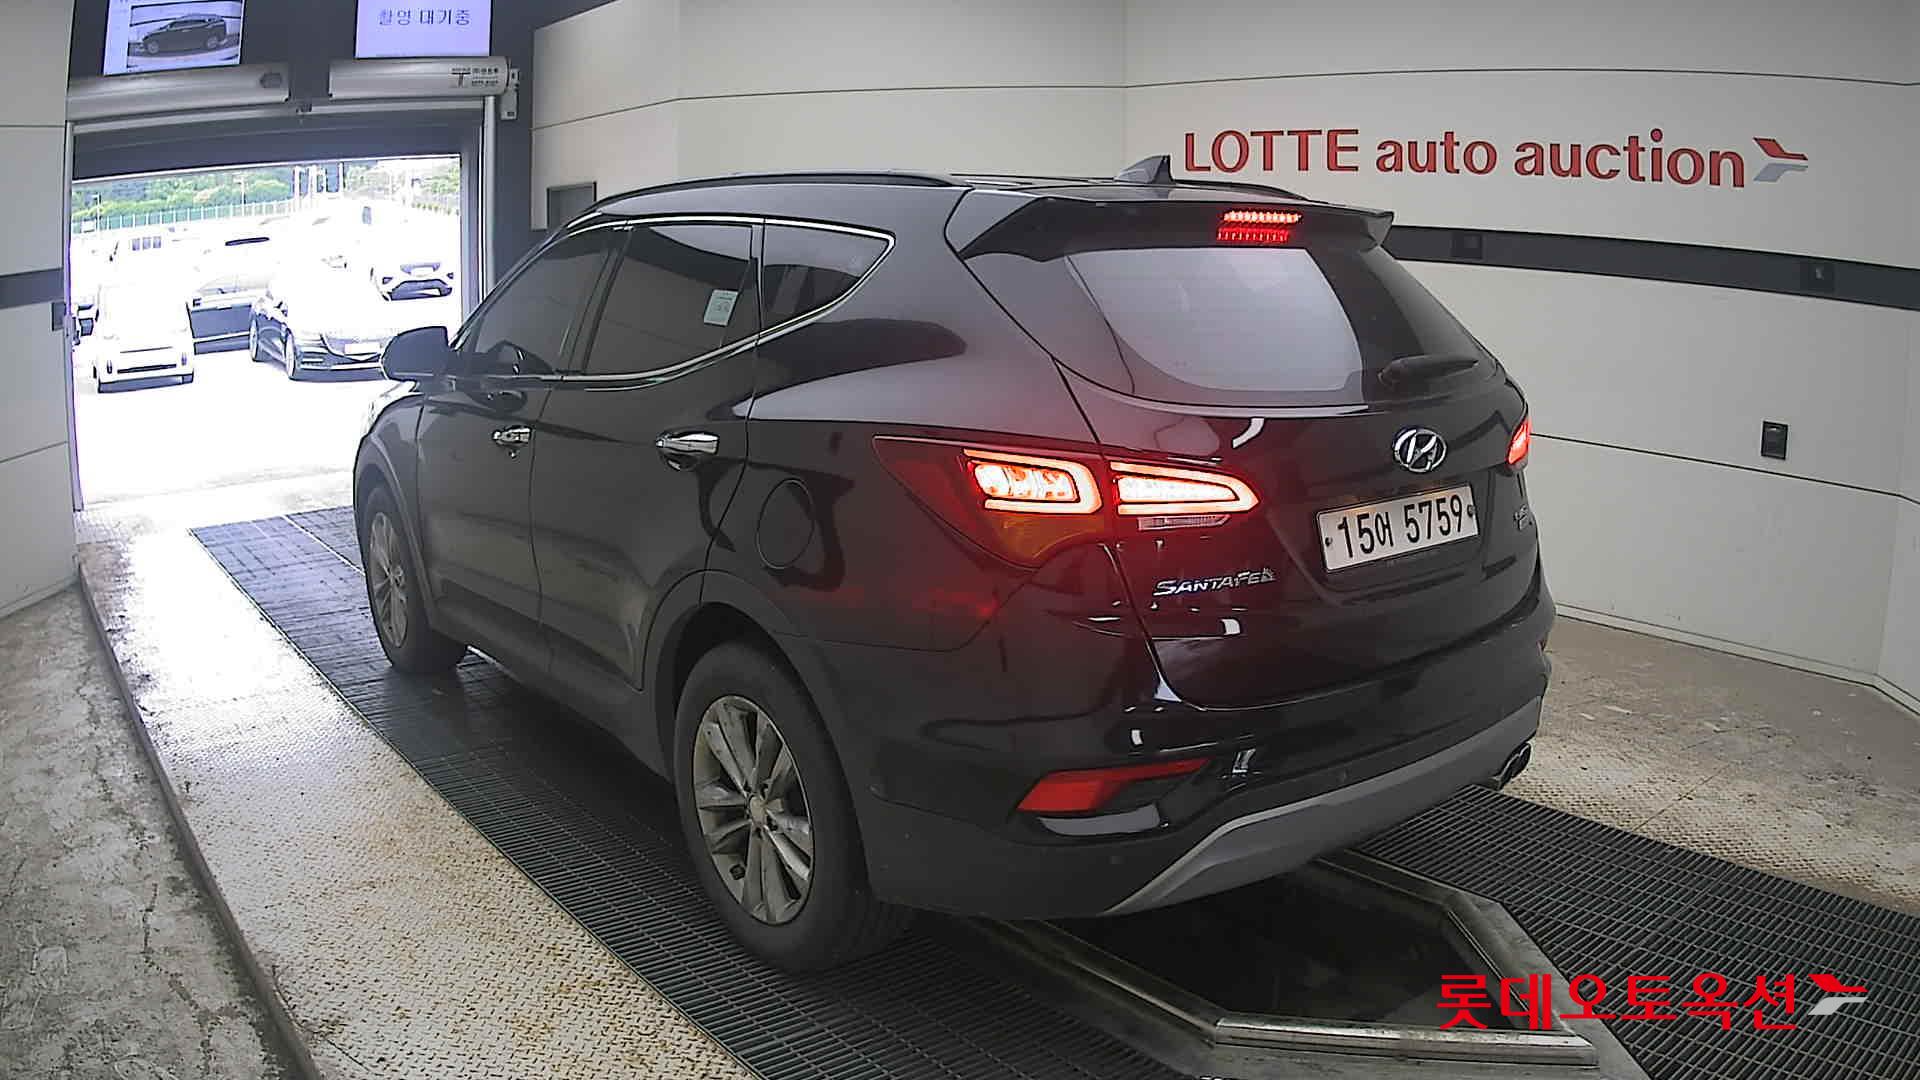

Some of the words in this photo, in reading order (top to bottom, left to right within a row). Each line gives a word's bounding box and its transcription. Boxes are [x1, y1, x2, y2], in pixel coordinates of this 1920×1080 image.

[419, 8, 471, 26] 대기중
[1185, 128, 1359, 172] LOTTE
[1376, 131, 1498, 174] auto
[1514, 128, 1745, 188] auction
[1337, 511, 1394, 558] 15어
[1403, 494, 1463, 544] 5759
